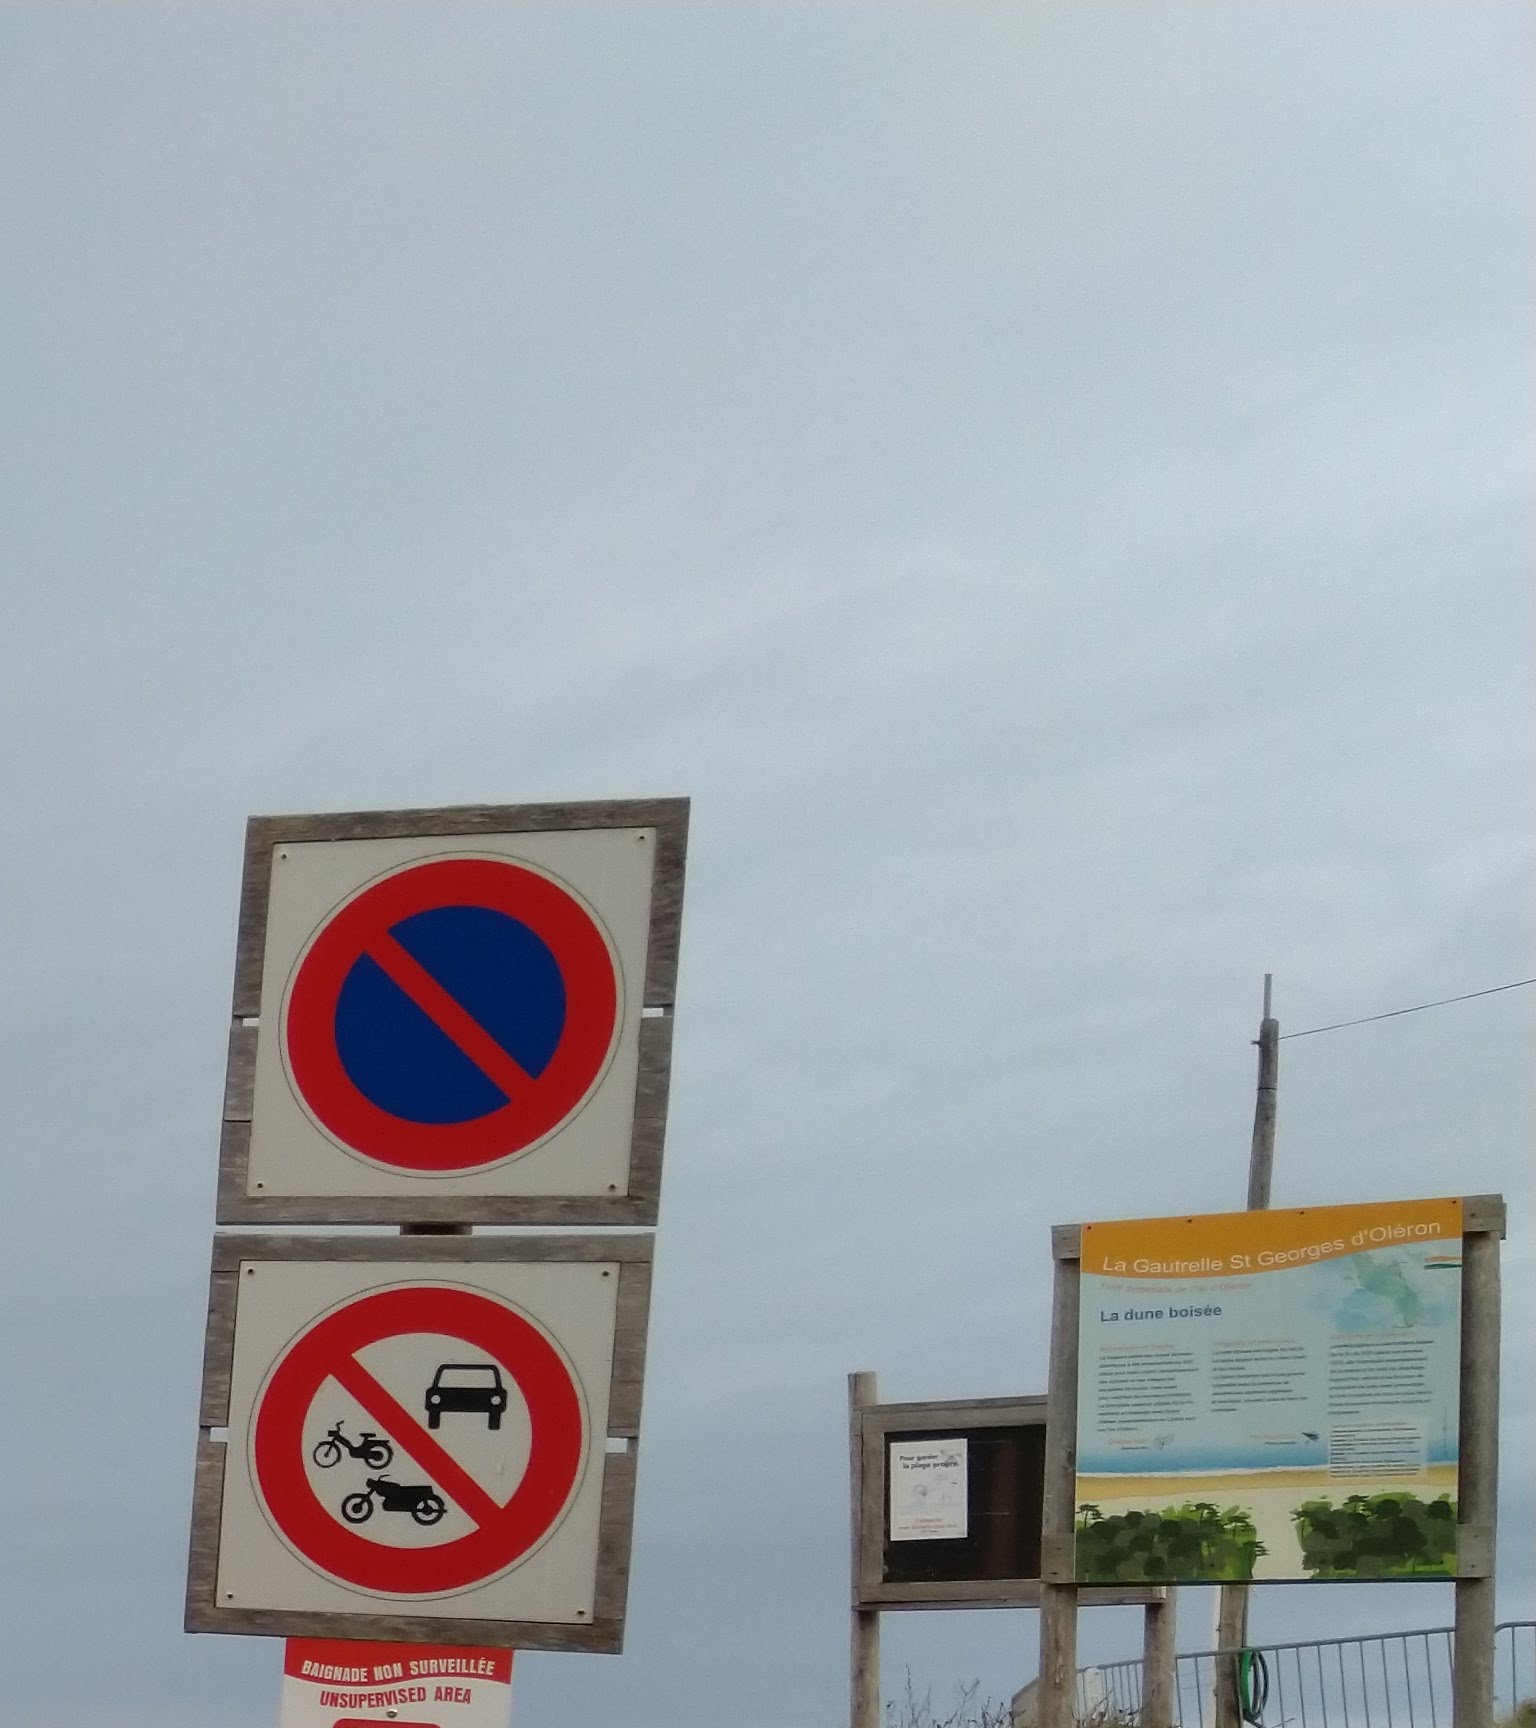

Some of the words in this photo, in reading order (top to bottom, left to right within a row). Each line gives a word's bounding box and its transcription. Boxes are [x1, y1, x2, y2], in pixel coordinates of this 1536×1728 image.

[1103, 1256, 1126, 1271] La
[1133, 1258, 1223, 1273] Gautrelle
[1230, 1254, 1251, 1270] St
[1258, 1239, 1345, 1266] Georges
[1351, 1222, 1441, 1246] d'Oléron
[1100, 1311, 1119, 1322] La
[1124, 1308, 1164, 1321] dune
[1169, 1304, 1222, 1319] boisée
[301, 1660, 368, 1682] BAIGNADE
[373, 1663, 403, 1680] NON
[410, 1657, 496, 1676] SURVEILLÉE
[320, 1686, 427, 1709] UNSUPERVISED
[434, 1686, 472, 1704] AREA
